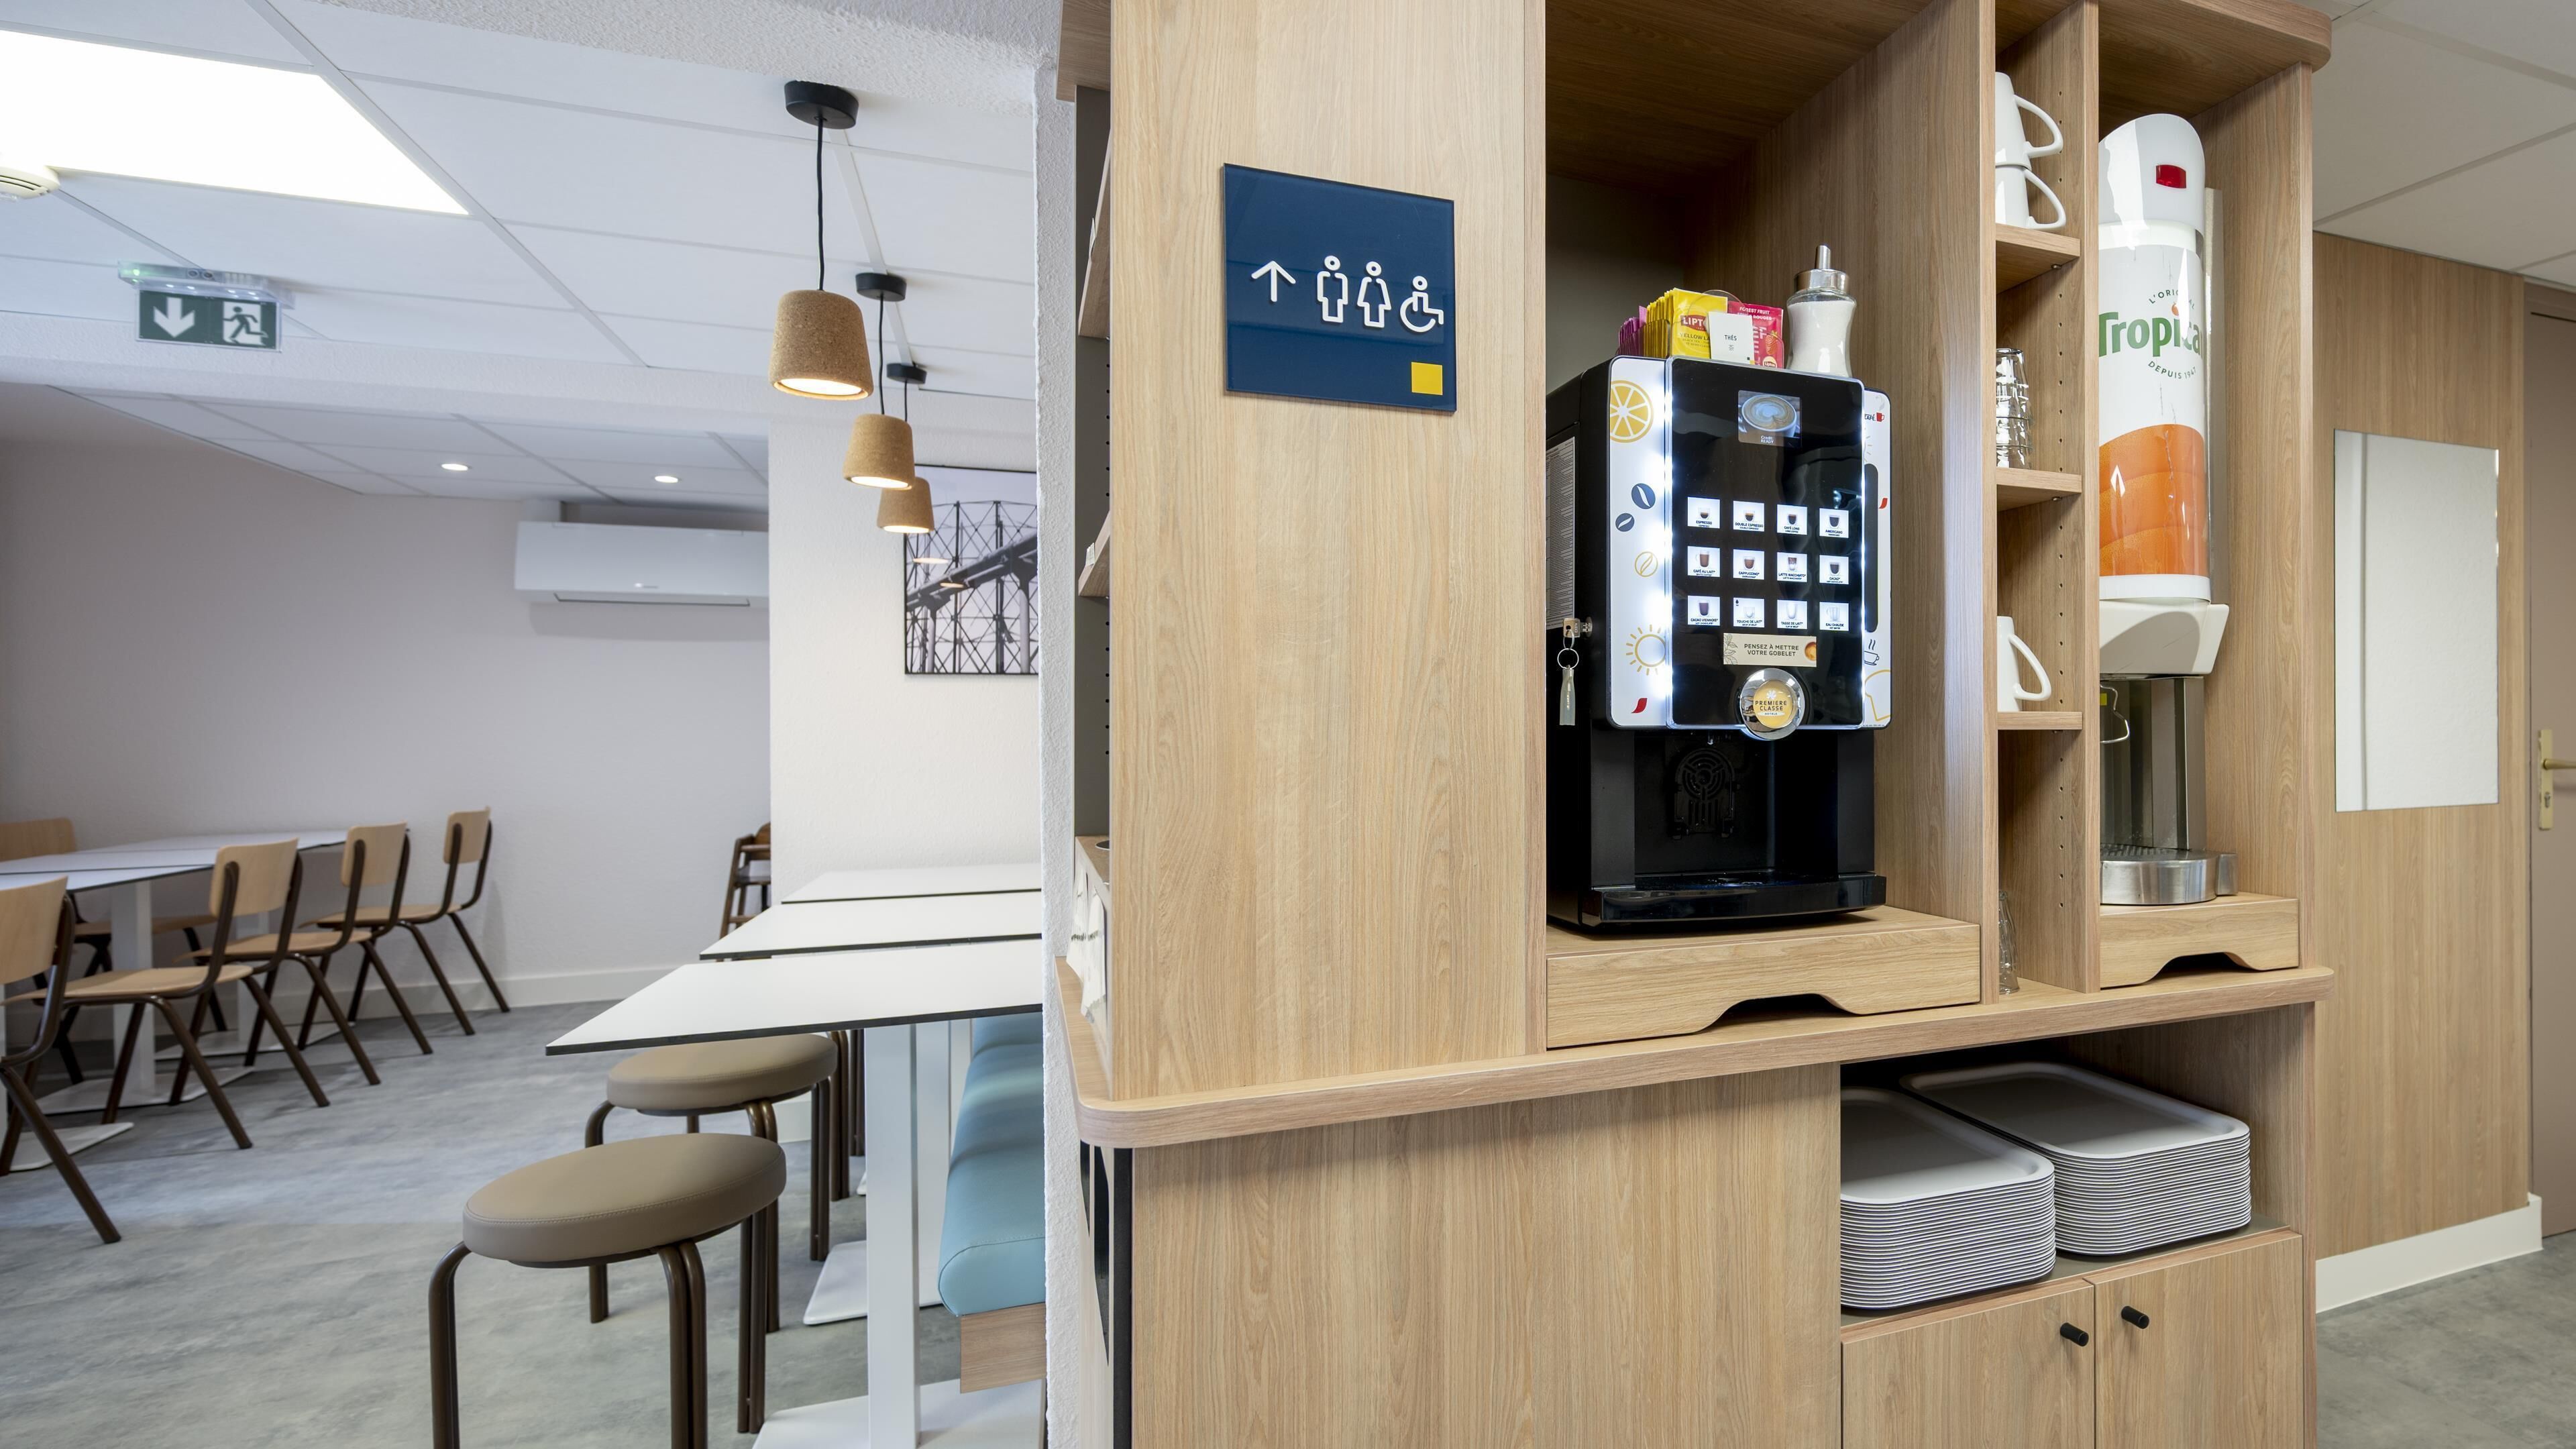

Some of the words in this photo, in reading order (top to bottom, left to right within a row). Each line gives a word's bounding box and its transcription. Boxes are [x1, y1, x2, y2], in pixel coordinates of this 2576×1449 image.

[2098, 312, 2202, 360] Tropica
[2148, 361, 2182, 379] DEPUIS
[2184, 366, 2196, 379] 1947
